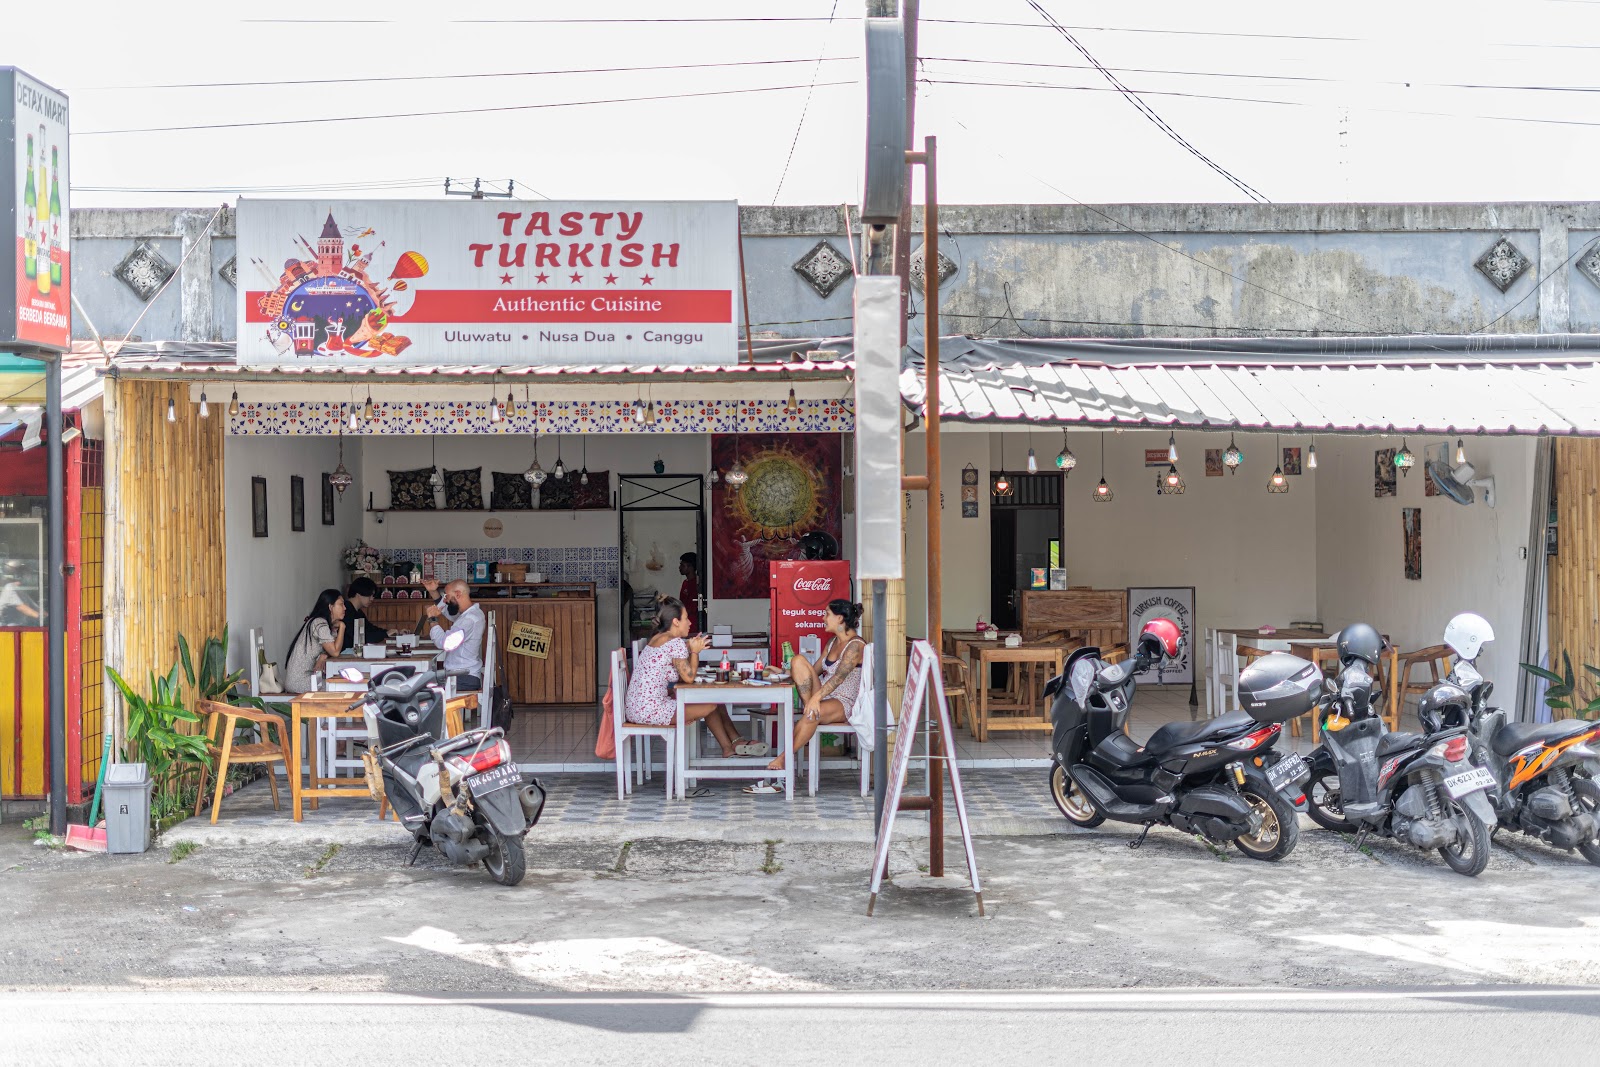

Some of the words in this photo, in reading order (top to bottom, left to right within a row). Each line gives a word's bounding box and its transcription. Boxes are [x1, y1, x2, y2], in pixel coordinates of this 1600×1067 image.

[17, 81, 42, 114] DETAX
[45, 96, 66, 126] MART
[497, 211, 643, 241] TASTY
[468, 242, 680, 268] TURKISH
[492, 296, 586, 312] Authentic
[591, 296, 662, 312] Cuisine
[444, 330, 512, 342] Uluwatu
[539, 331, 579, 342] Nusa
[584, 331, 616, 342] Dua
[643, 331, 703, 345] Canggu
[793, 577, 833, 591] Coca-Cola
[782, 609, 806, 617] teguk
[1132, 596, 1162, 617] TURKISH
[1163, 596, 1189, 618] COFFEE
[512, 636, 546, 654] OPEN
[470, 777, 482, 788] DK
[1446, 779, 1459, 788] DK
